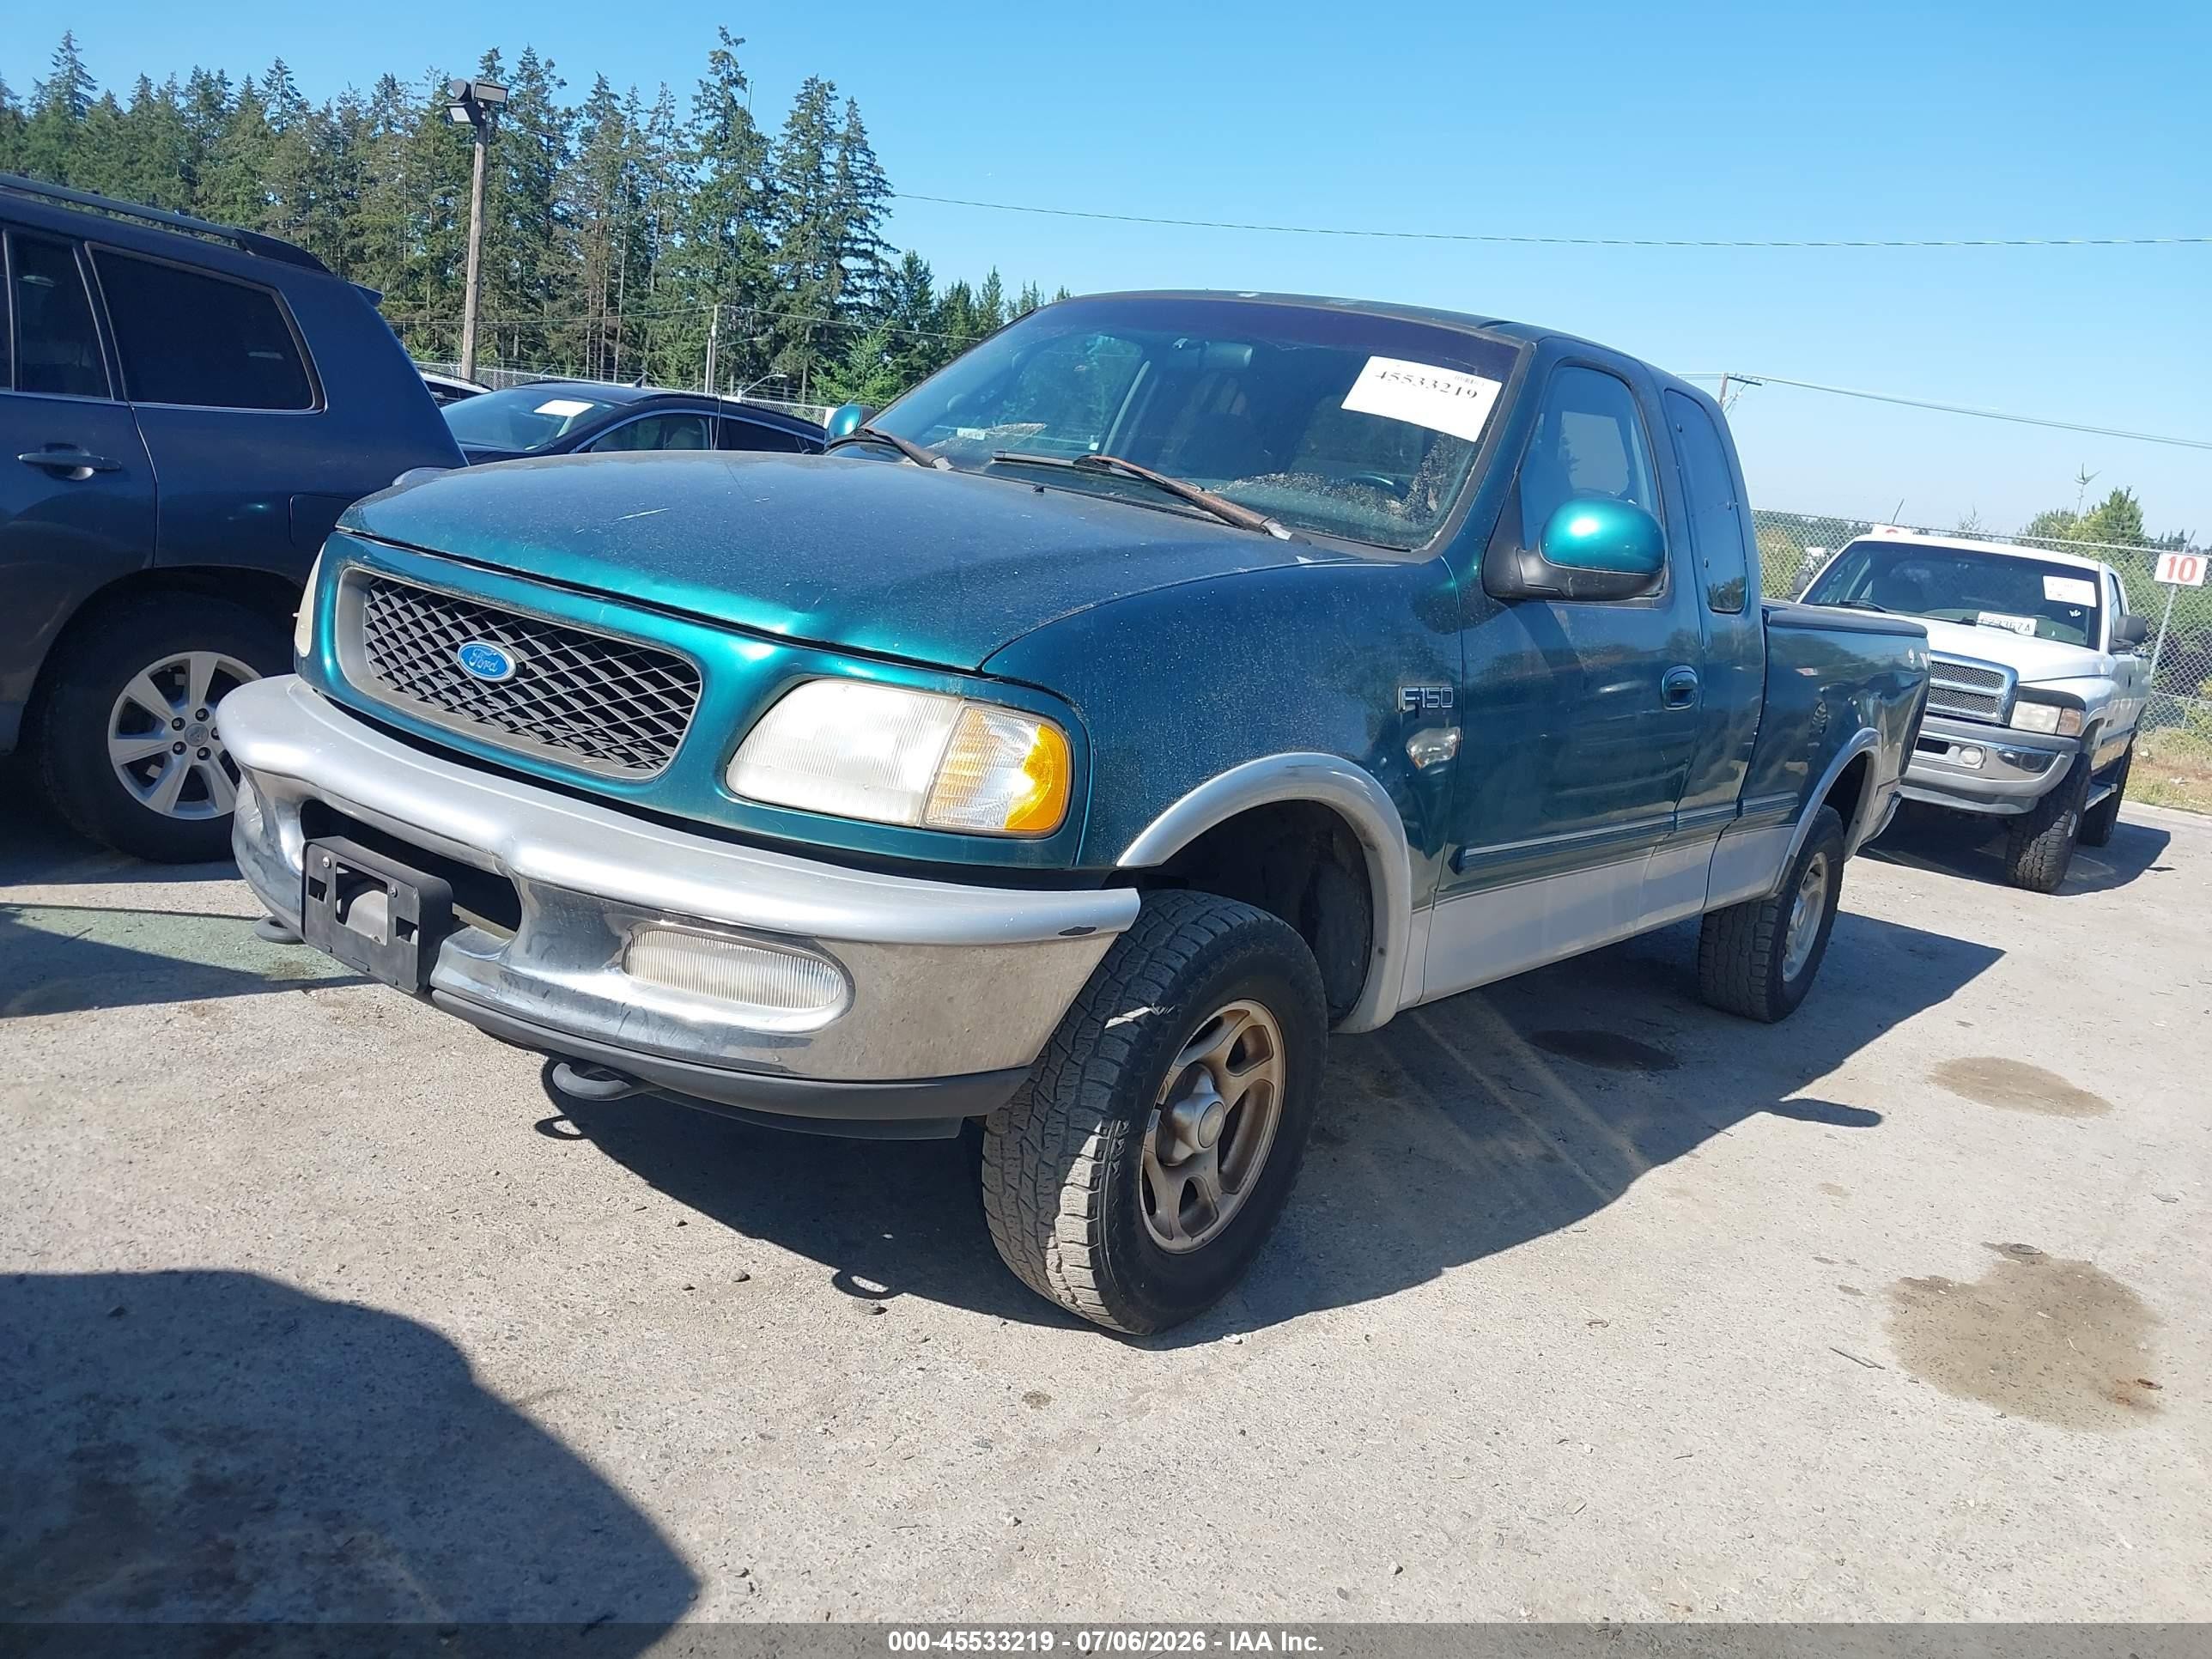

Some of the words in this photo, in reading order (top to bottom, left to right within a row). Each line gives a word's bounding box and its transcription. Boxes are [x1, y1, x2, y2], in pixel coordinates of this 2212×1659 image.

[1376, 370, 1478, 399] 45533219
[2167, 556, 2197, 582] 10
[469, 647, 499, 672] Ford
